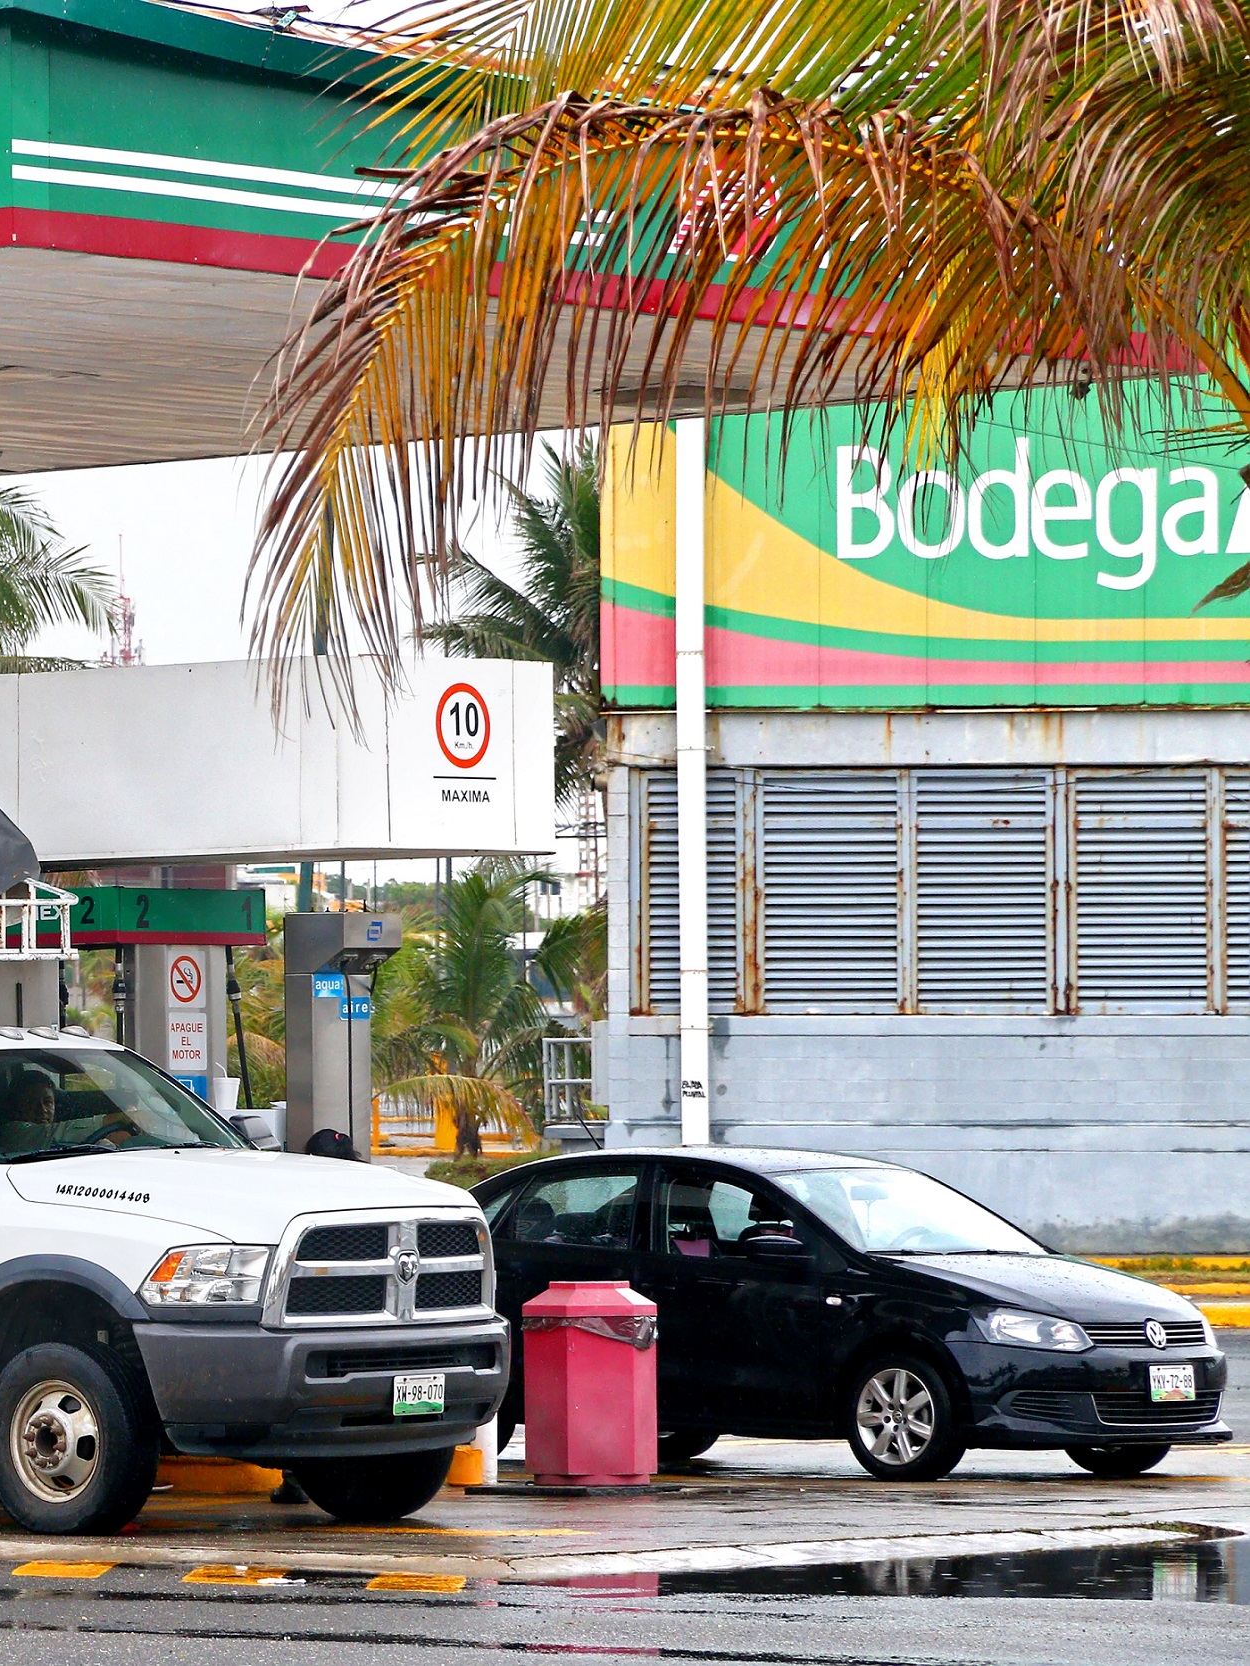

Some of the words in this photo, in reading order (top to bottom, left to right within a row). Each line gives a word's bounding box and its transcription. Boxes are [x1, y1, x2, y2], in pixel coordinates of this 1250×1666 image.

[836, 438, 1218, 590] Bodega
[450, 702, 479, 737] 10
[442, 790, 490, 802] MAXIMA
[80, 895, 95, 924] 2
[136, 894, 150, 929] 2
[241, 896, 252, 931] 1
[315, 980, 340, 991] agua
[170, 1023, 203, 1033] APAGUE
[181, 1036, 191, 1046] EL
[172, 1050, 201, 1059] MOTOR
